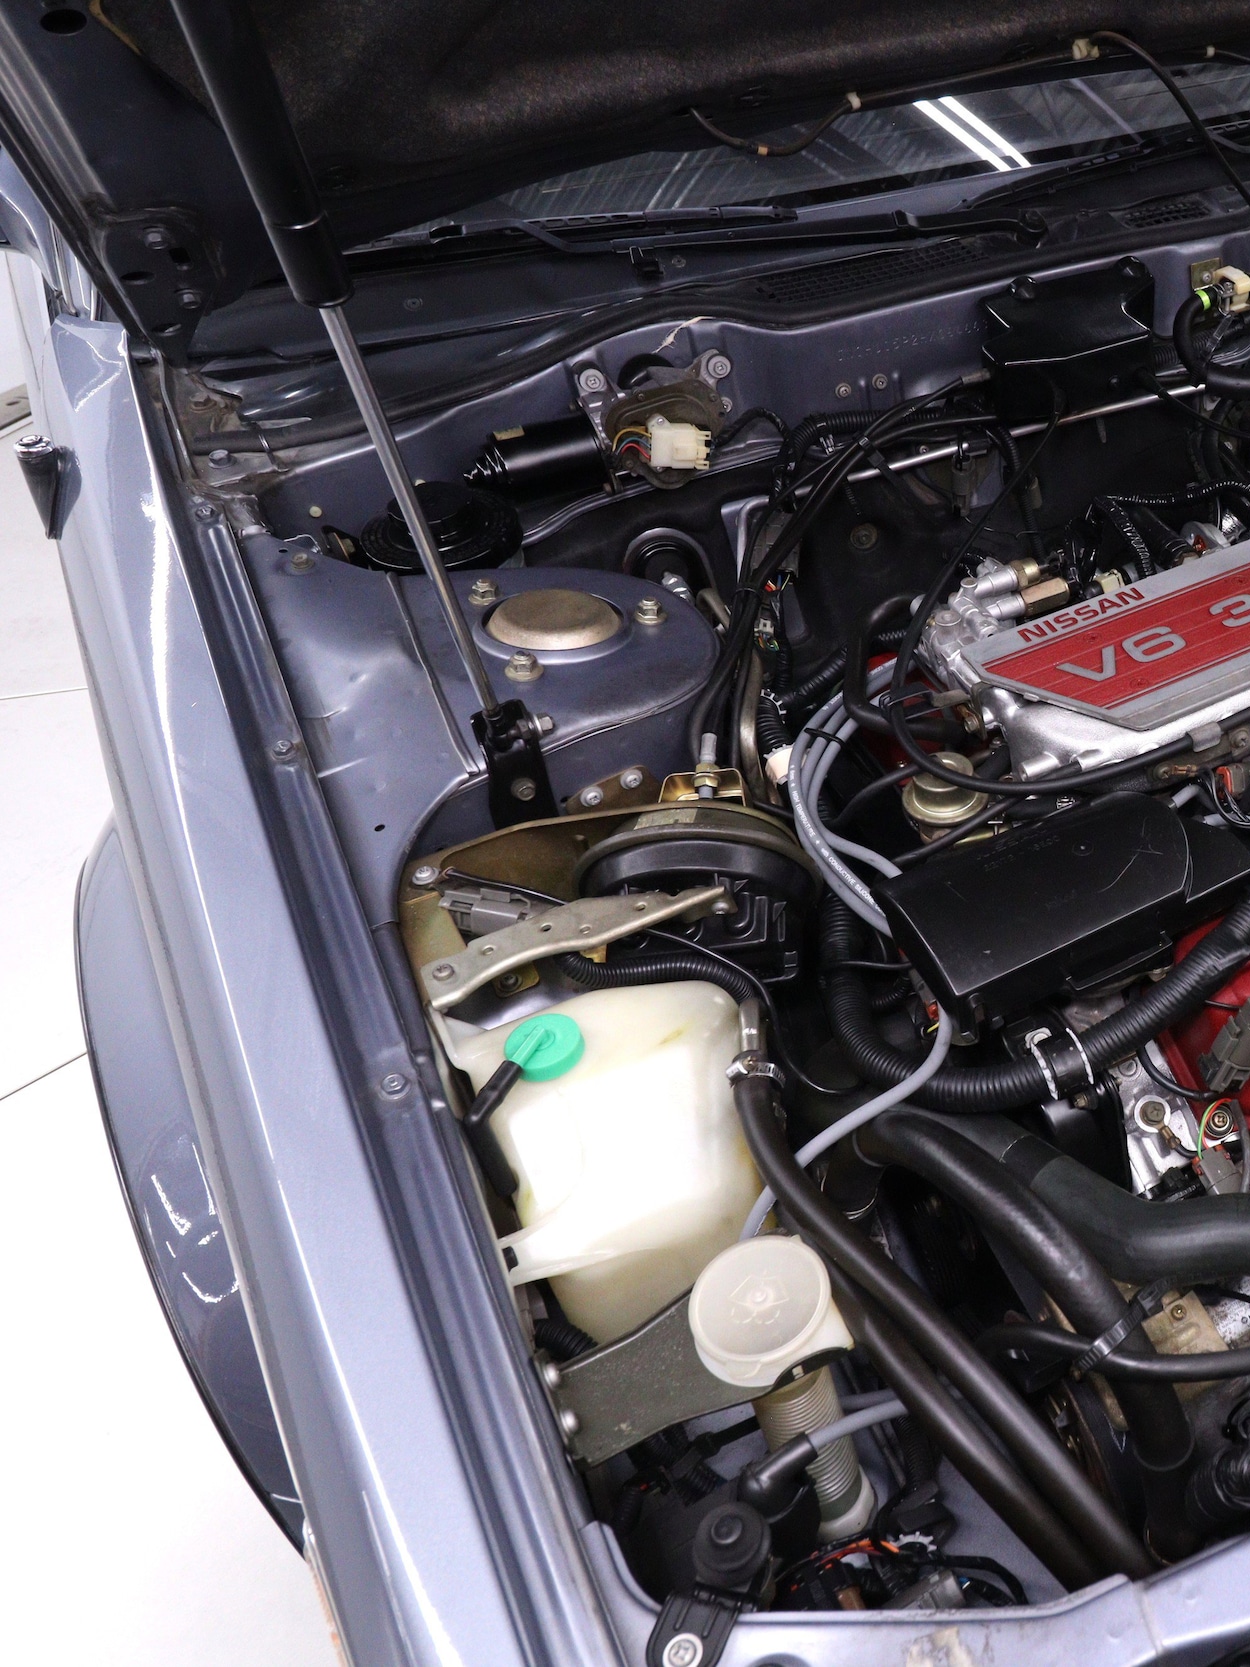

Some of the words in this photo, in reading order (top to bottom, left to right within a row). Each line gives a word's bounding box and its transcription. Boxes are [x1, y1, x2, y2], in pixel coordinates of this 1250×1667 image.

[1016, 587, 1146, 643] NISSAN
[1056, 625, 1187, 683] V6
[795, 803, 816, 838] TEMPERATURE
[828, 856, 856, 886] CONDUCTIVE
